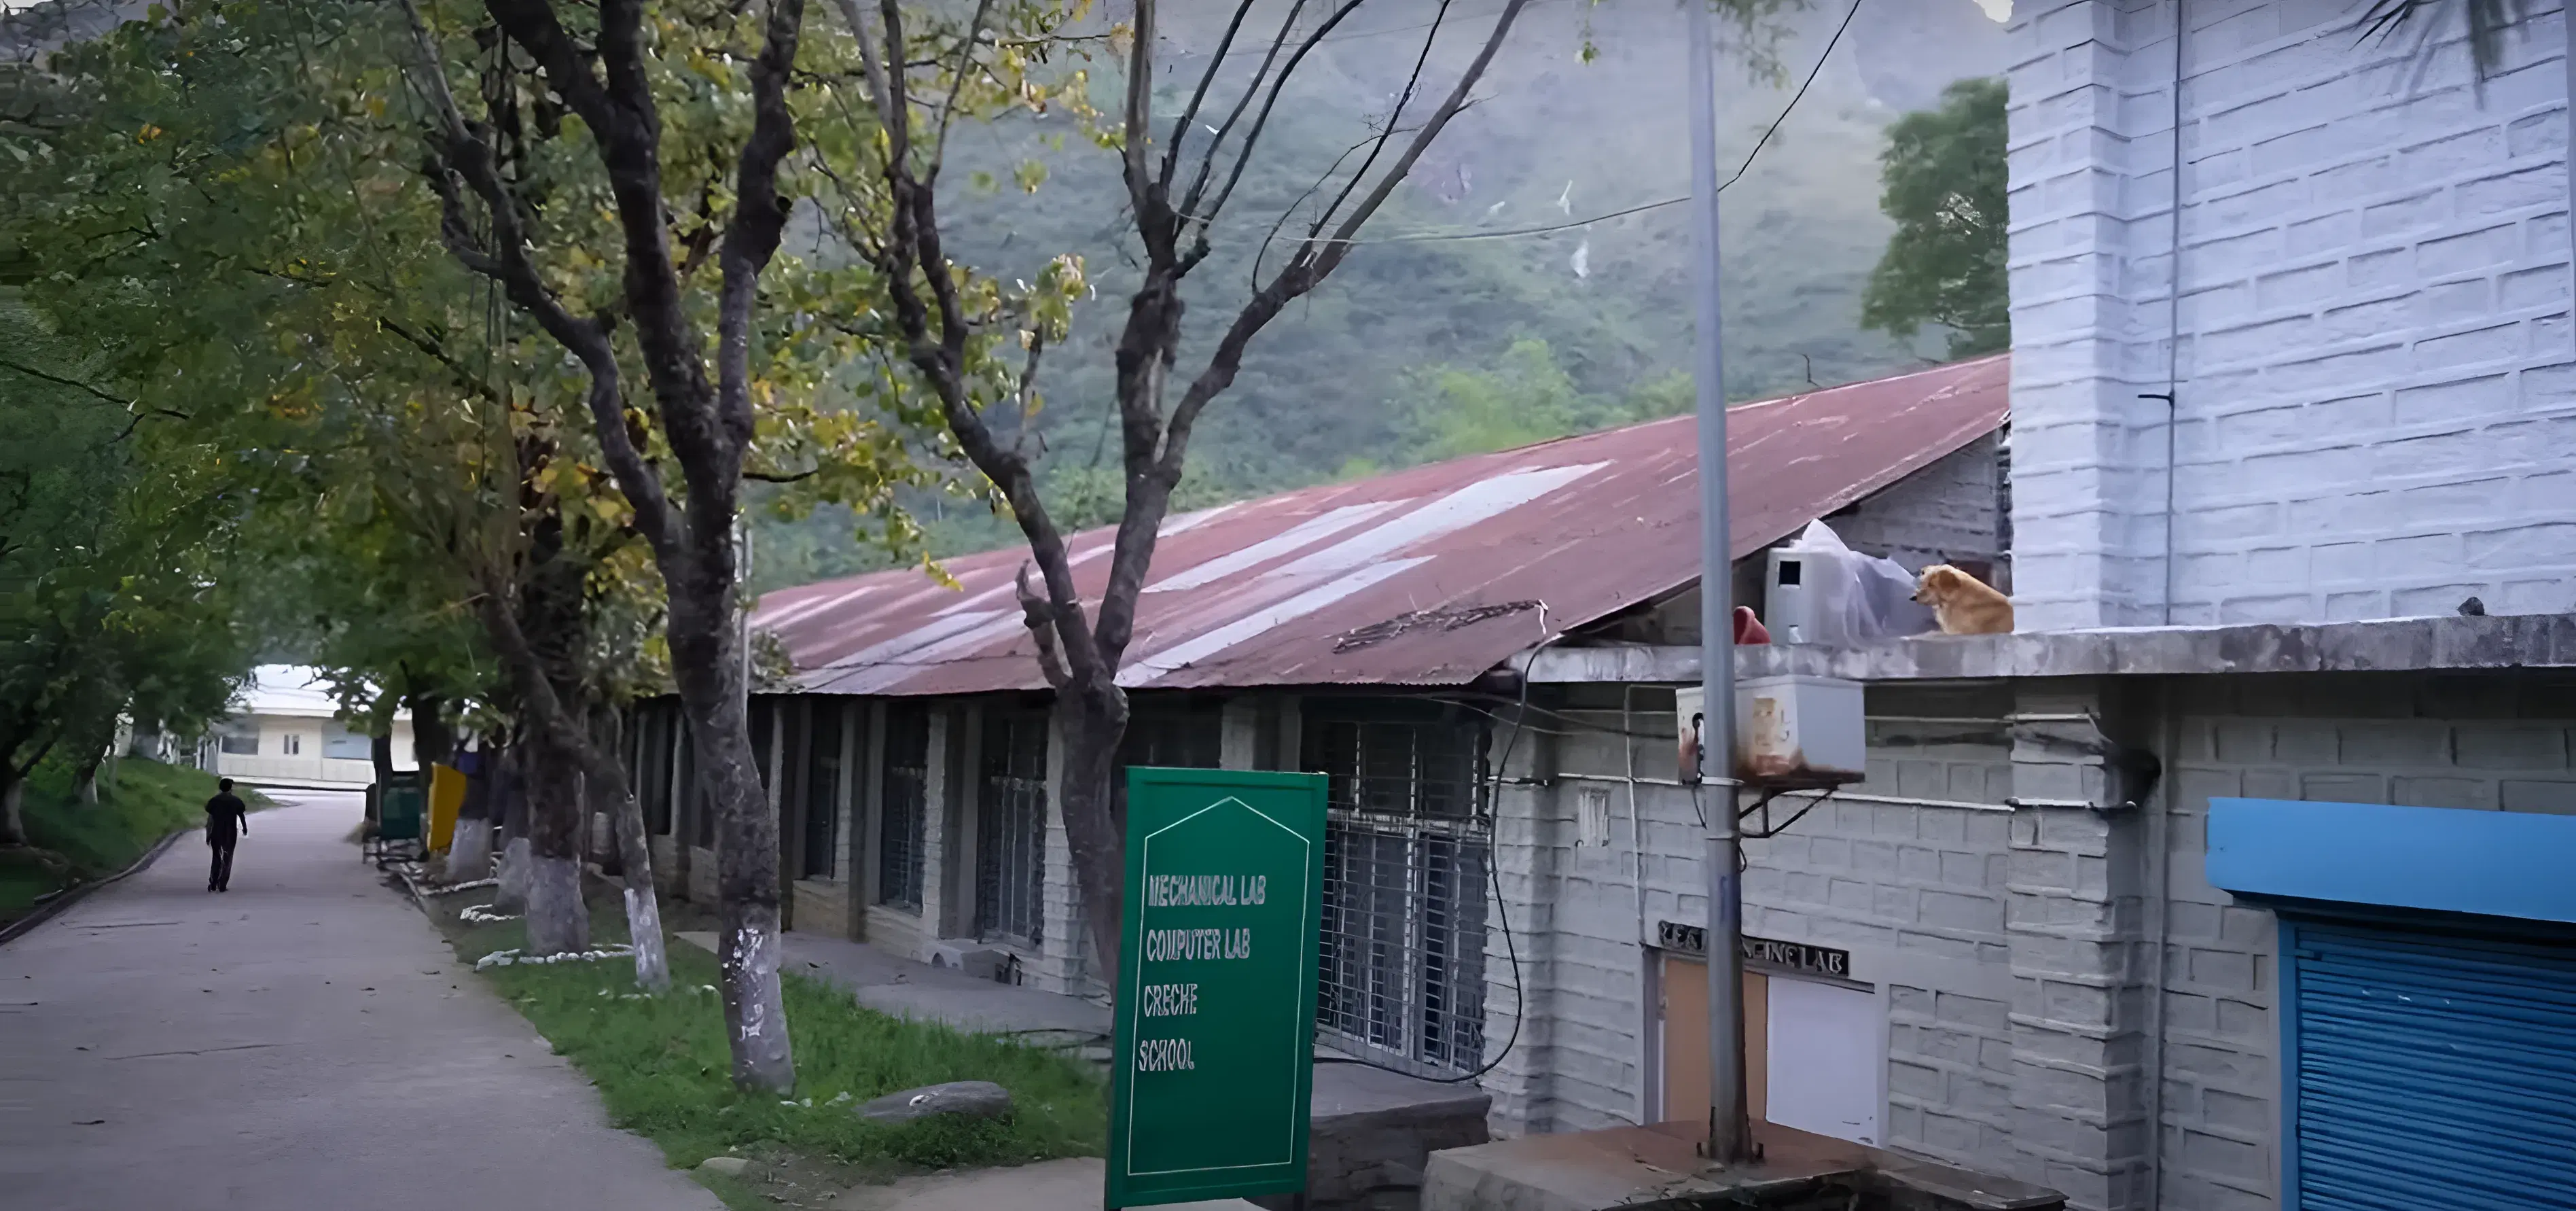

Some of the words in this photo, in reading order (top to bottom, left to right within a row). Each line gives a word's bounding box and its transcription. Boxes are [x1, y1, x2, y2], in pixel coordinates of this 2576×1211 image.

[1148, 875, 1237, 907] MECHANICAL
[1240, 875, 1266, 905] LAB
[1147, 928, 1221, 962] COMPUTER
[1224, 928, 1251, 960] LAB
[1799, 946, 1842, 974] LAB
[1144, 983, 1198, 1017] CRECHE
[1139, 1038, 1195, 1071] SCHOOL
